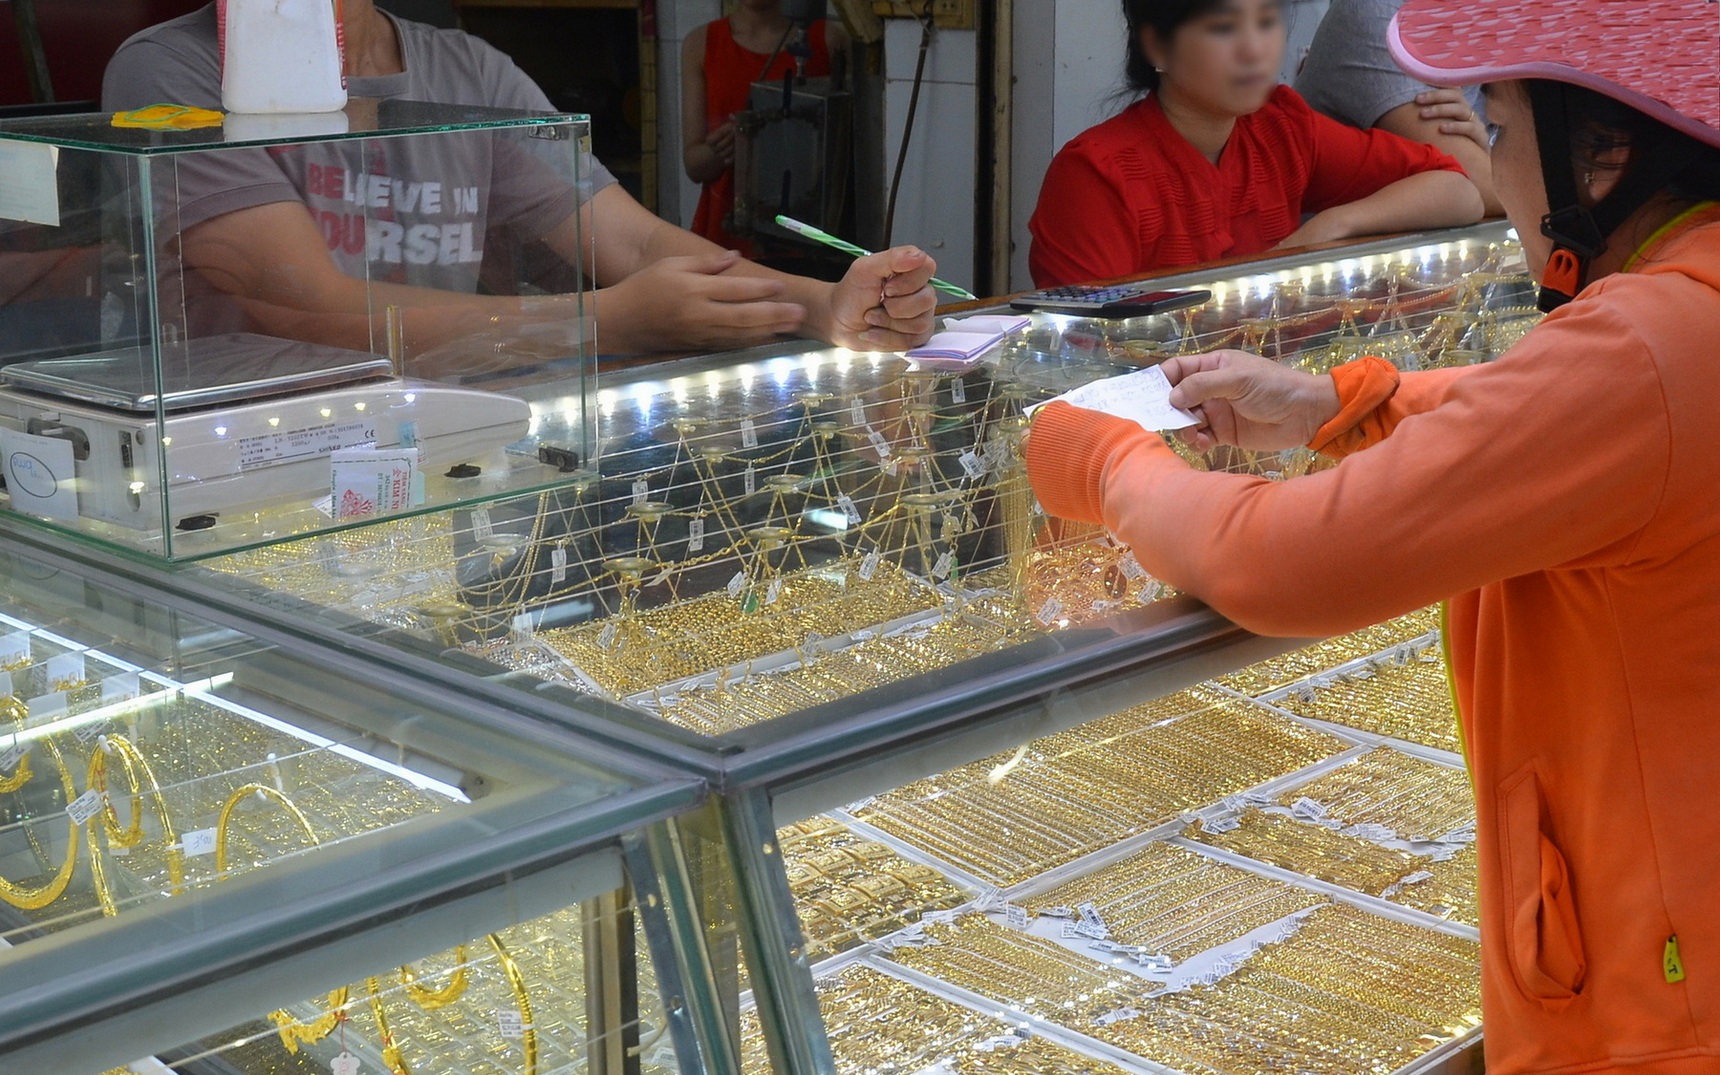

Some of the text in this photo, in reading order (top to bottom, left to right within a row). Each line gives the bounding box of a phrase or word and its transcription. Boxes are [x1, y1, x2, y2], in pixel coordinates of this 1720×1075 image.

[308, 163, 478, 214] BELIEVE IN
[392, 480, 400, 497] KIM
